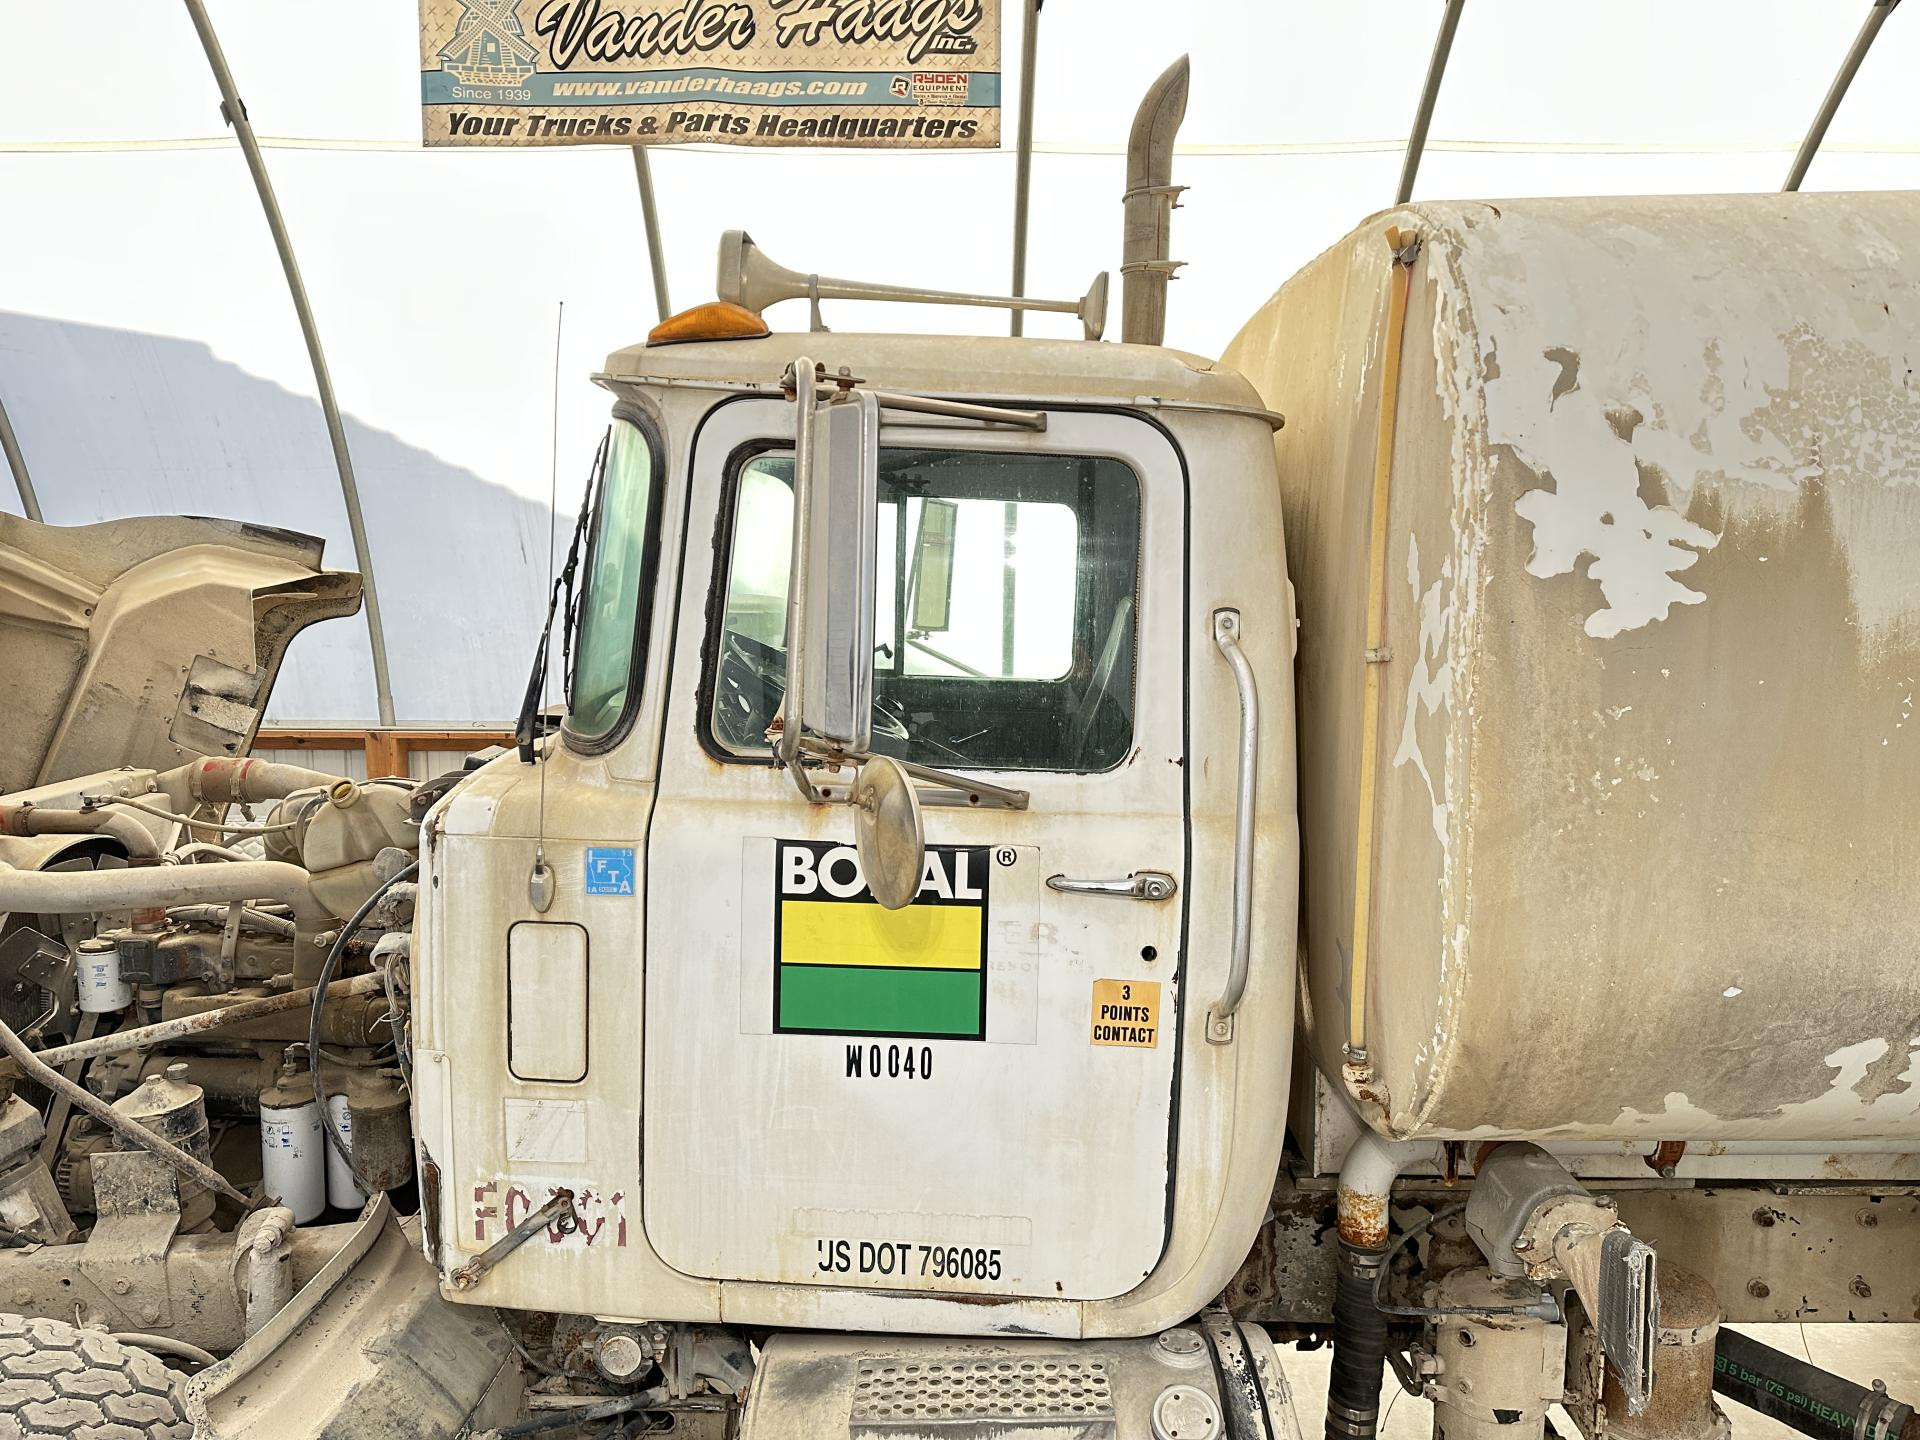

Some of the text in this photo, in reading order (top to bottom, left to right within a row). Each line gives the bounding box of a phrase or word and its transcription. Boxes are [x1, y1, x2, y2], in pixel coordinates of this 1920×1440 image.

[534, 0, 983, 71] Vander Haags
[929, 33, 977, 54] Inc.
[552, 79, 868, 97] www.vanderhaags.com
[913, 74, 967, 83] RYDEN
[451, 86, 531, 100] Since 1939
[449, 111, 978, 139] Your Trucks & Parts Headquarters
[782, 846, 982, 900] BOAL
[1122, 985, 1131, 1000] 3
[1101, 1005, 1149, 1022] POINTS
[1094, 1025, 1155, 1043] CONTACT
[846, 1044, 932, 1080] W0040
[859, 1241, 912, 1275] DOT
[919, 1245, 1002, 1281] 796085
[1729, 1363, 1737, 1375] 5
[1740, 1368, 1763, 1387] bar
[1765, 1379, 1785, 1397] (75
[1786, 1391, 1808, 1408] psi)
